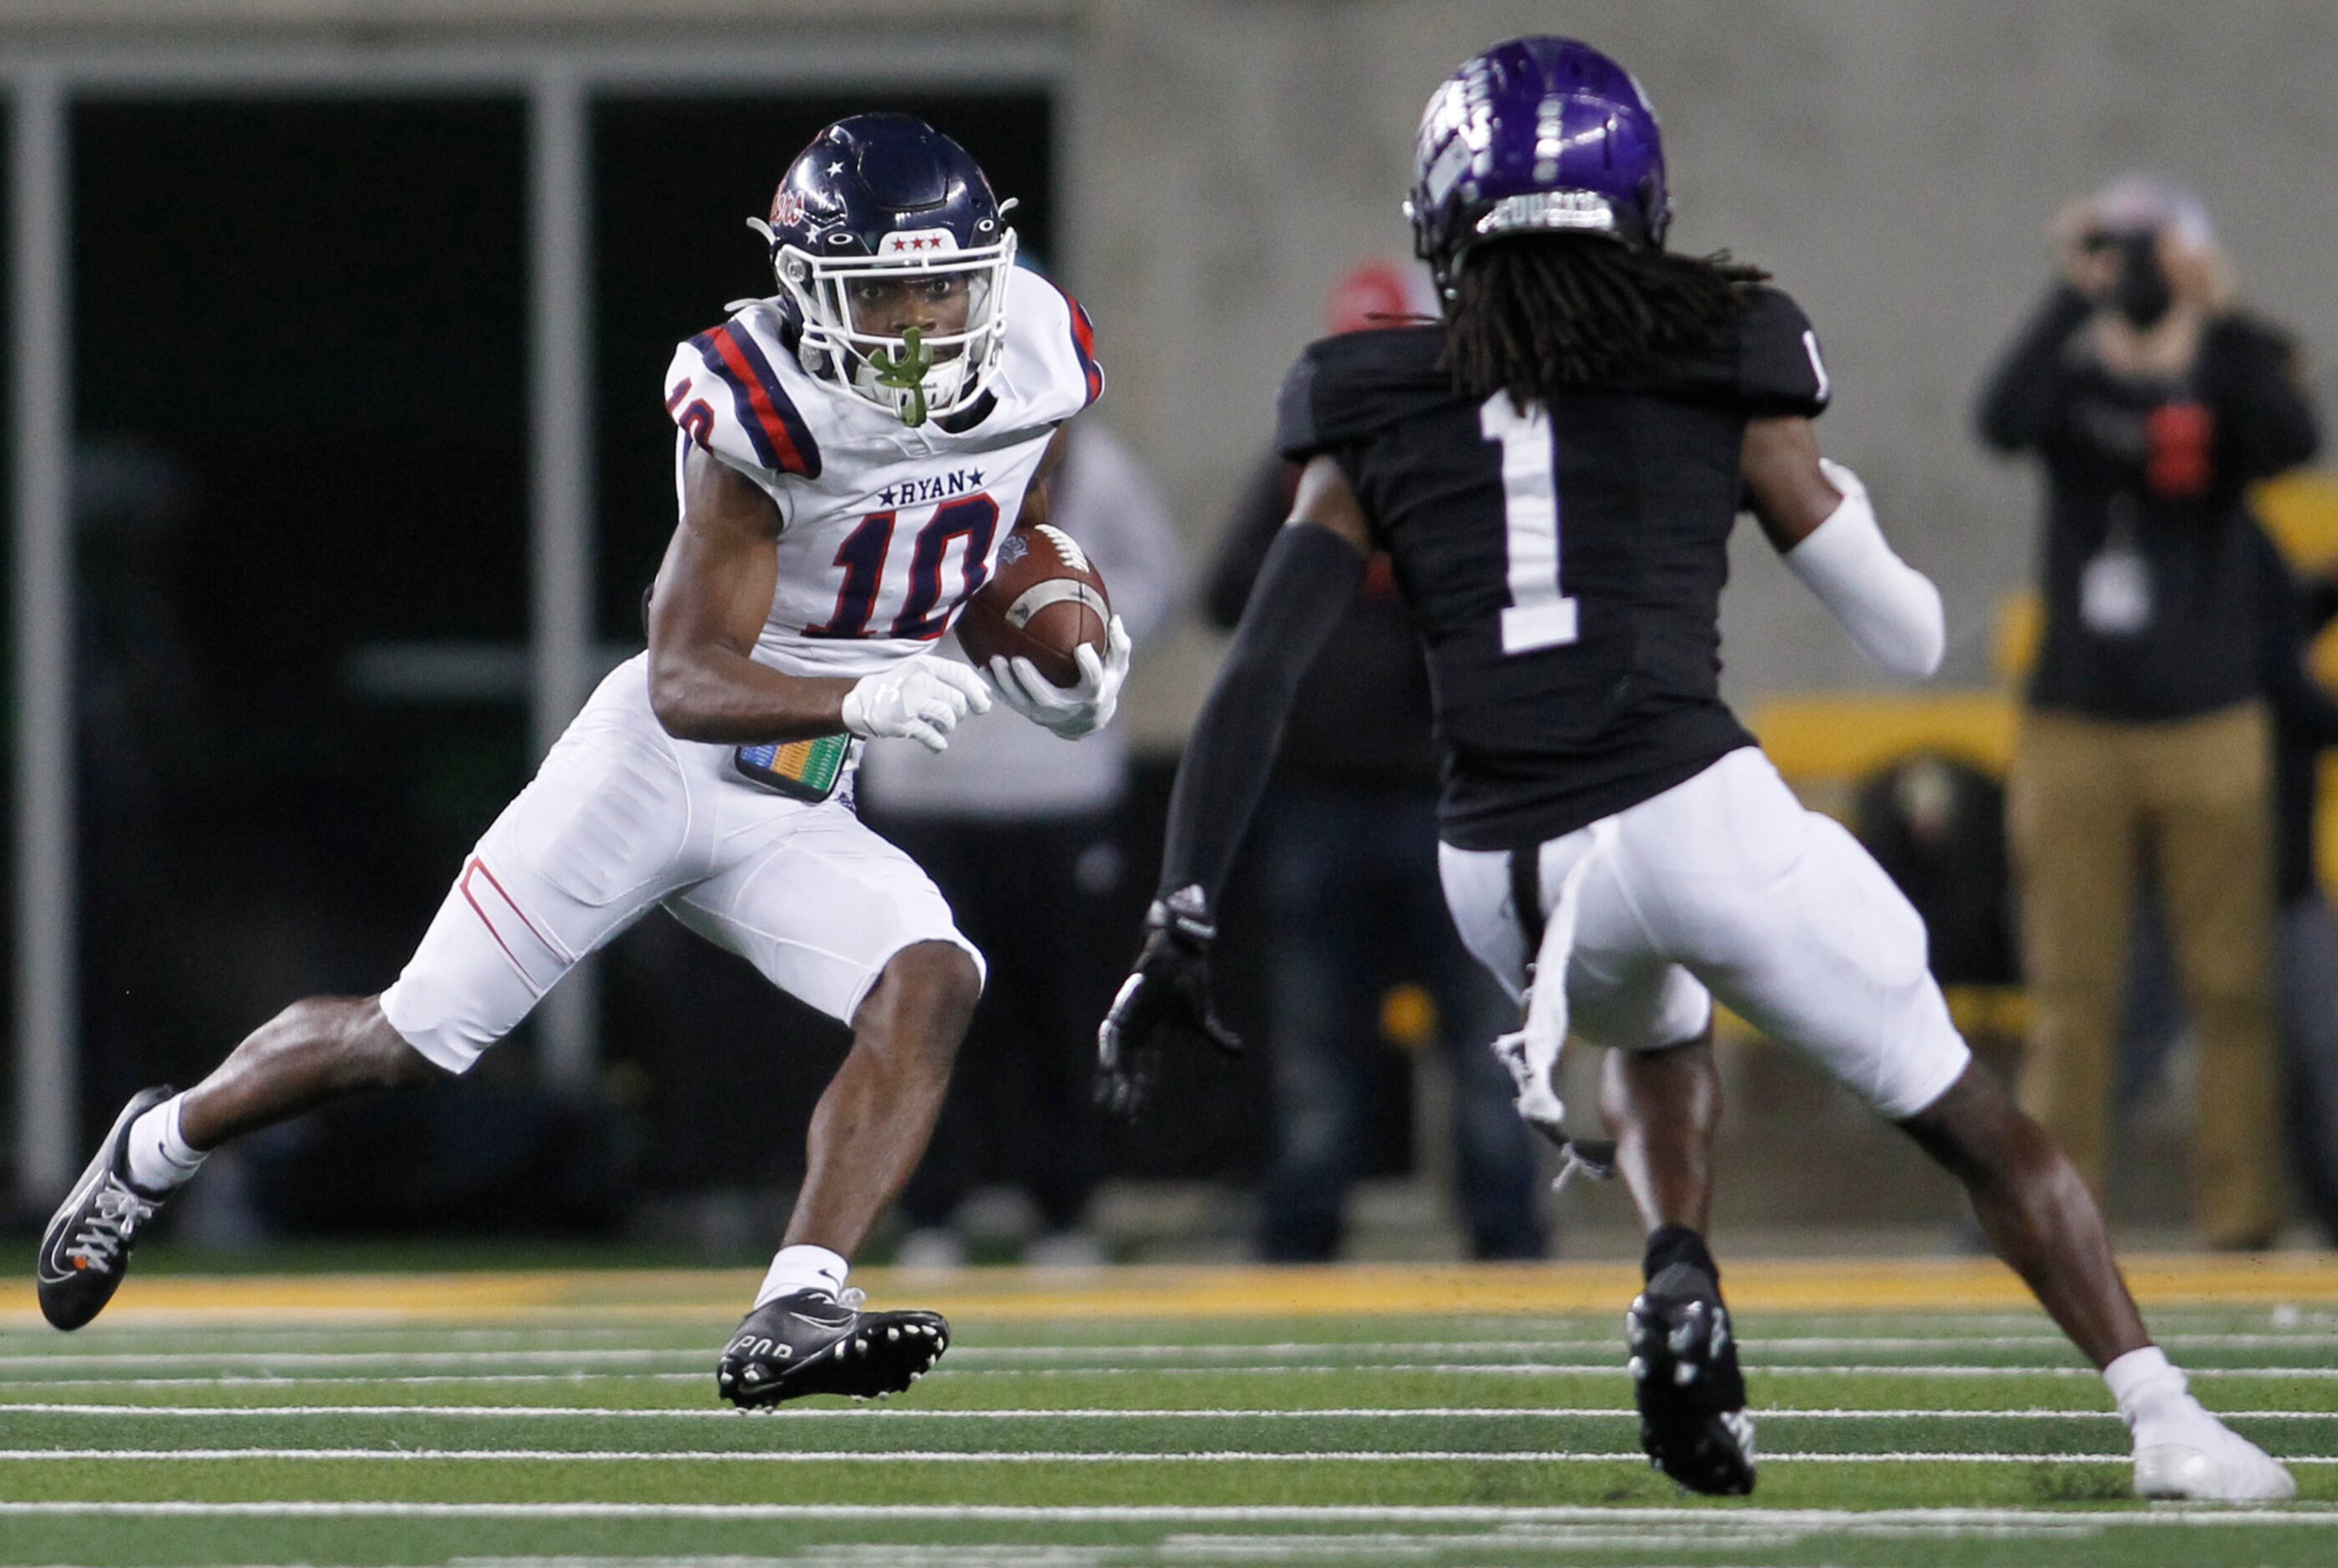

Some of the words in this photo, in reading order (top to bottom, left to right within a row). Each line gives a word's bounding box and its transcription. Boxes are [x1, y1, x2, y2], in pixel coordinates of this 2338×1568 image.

[899, 469, 965, 505] RYAN
[1480, 387, 1578, 655] 1
[799, 492, 1000, 641] 10
